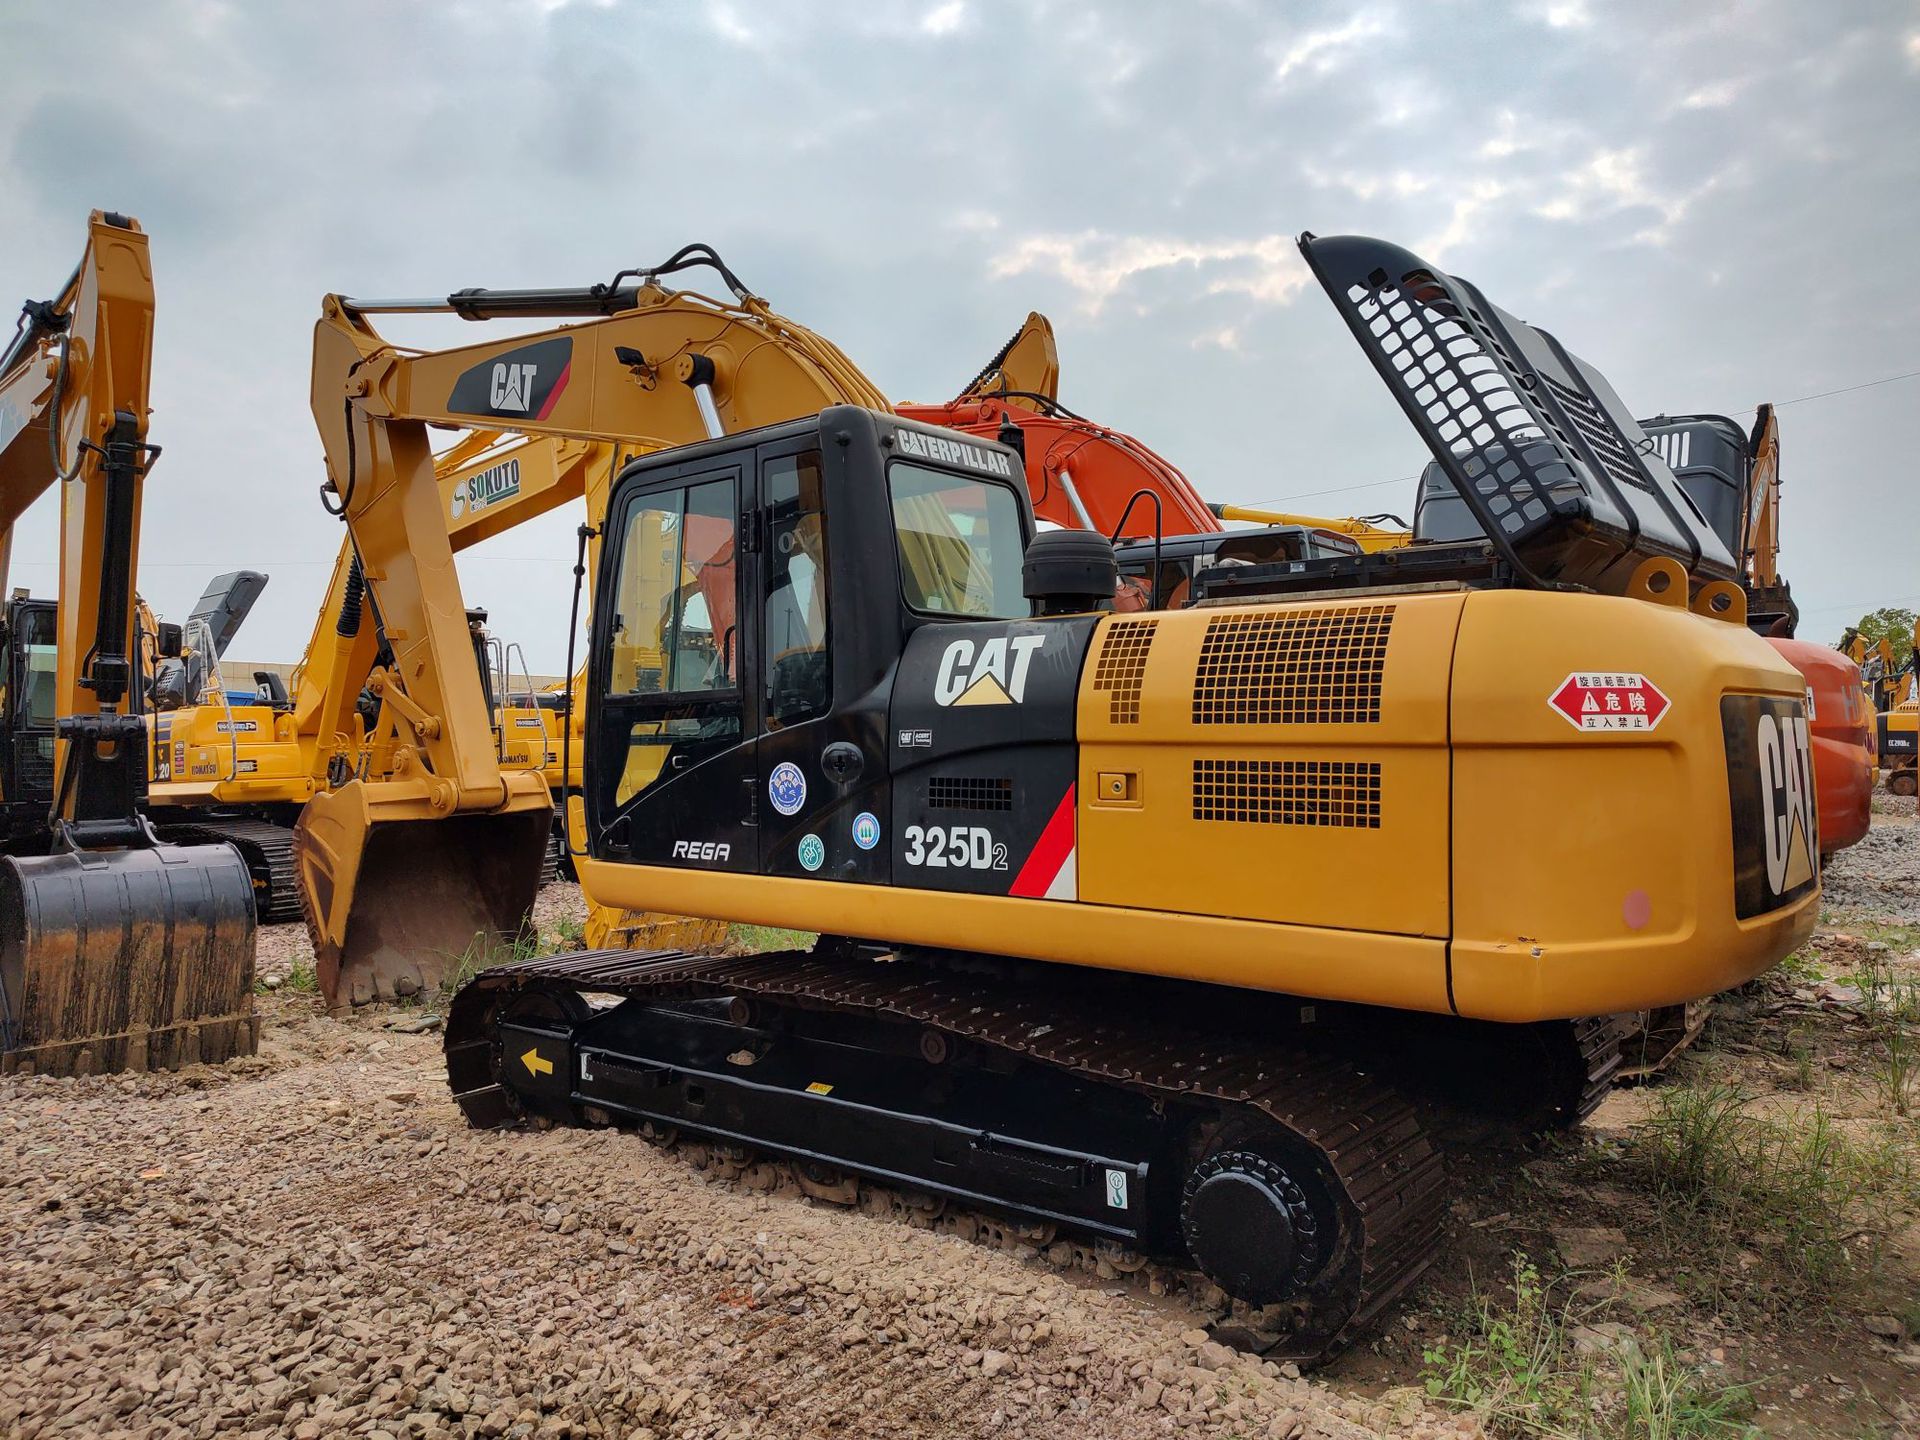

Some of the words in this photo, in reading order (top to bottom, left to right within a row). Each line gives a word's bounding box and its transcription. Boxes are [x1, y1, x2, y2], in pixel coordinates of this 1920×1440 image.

[490, 363, 537, 411] CAT
[898, 429, 1011, 476] CATERPILLAR
[468, 458, 520, 502] SOKUTO
[934, 634, 1046, 707] CAT
[1586, 717, 1643, 728] 立入禁止
[1604, 691, 1647, 712] 危険
[1757, 714, 1816, 896] CAT
[672, 840, 731, 861] REGA
